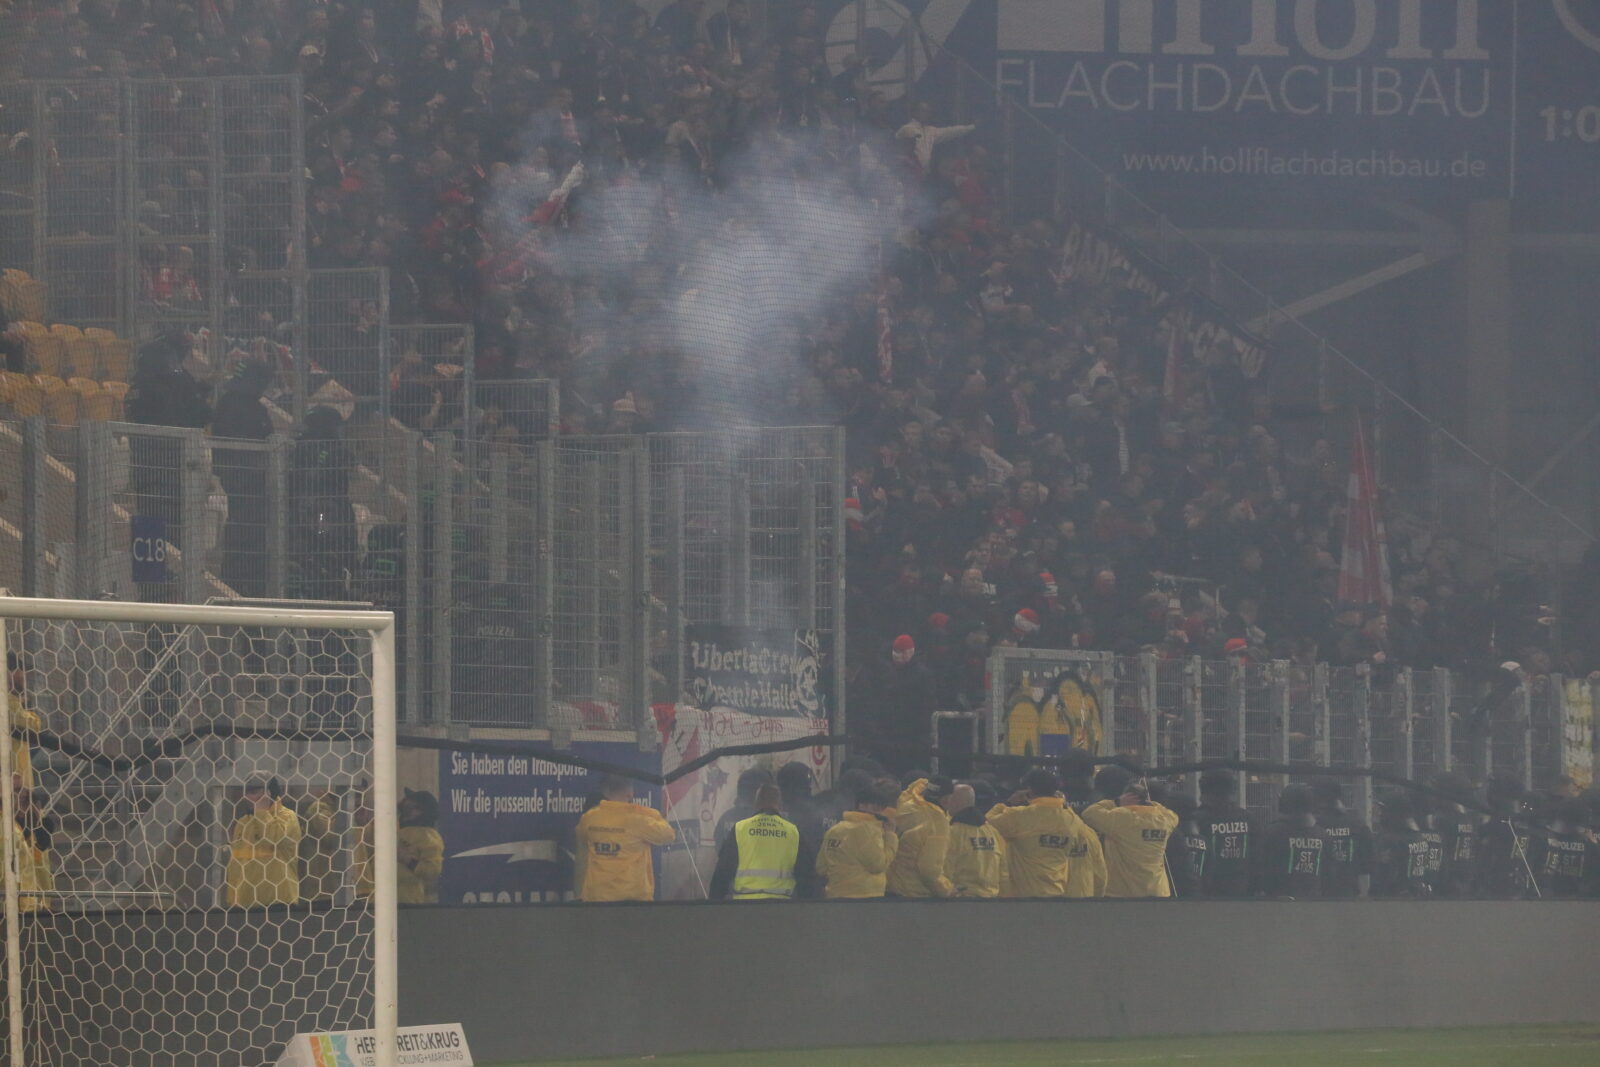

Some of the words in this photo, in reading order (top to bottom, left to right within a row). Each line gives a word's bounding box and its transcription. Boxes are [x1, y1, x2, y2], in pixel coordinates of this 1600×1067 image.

[996, 59, 1491, 118] FLACHDACHBAU
[1122, 147, 1487, 178] www.hollflachdachbau.de
[133, 537, 165, 562] C18
[452, 750, 468, 776] Sie
[471, 752, 504, 776] haben
[508, 755, 527, 776] den
[451, 788, 471, 813] Wir
[474, 788, 492, 813] die
[494, 788, 543, 818] passende
[749, 828, 787, 839] ORDNER
[1211, 822, 1248, 834] POLIZEI
[1224, 836, 1237, 848] ST
[1300, 851, 1312, 863] ST
